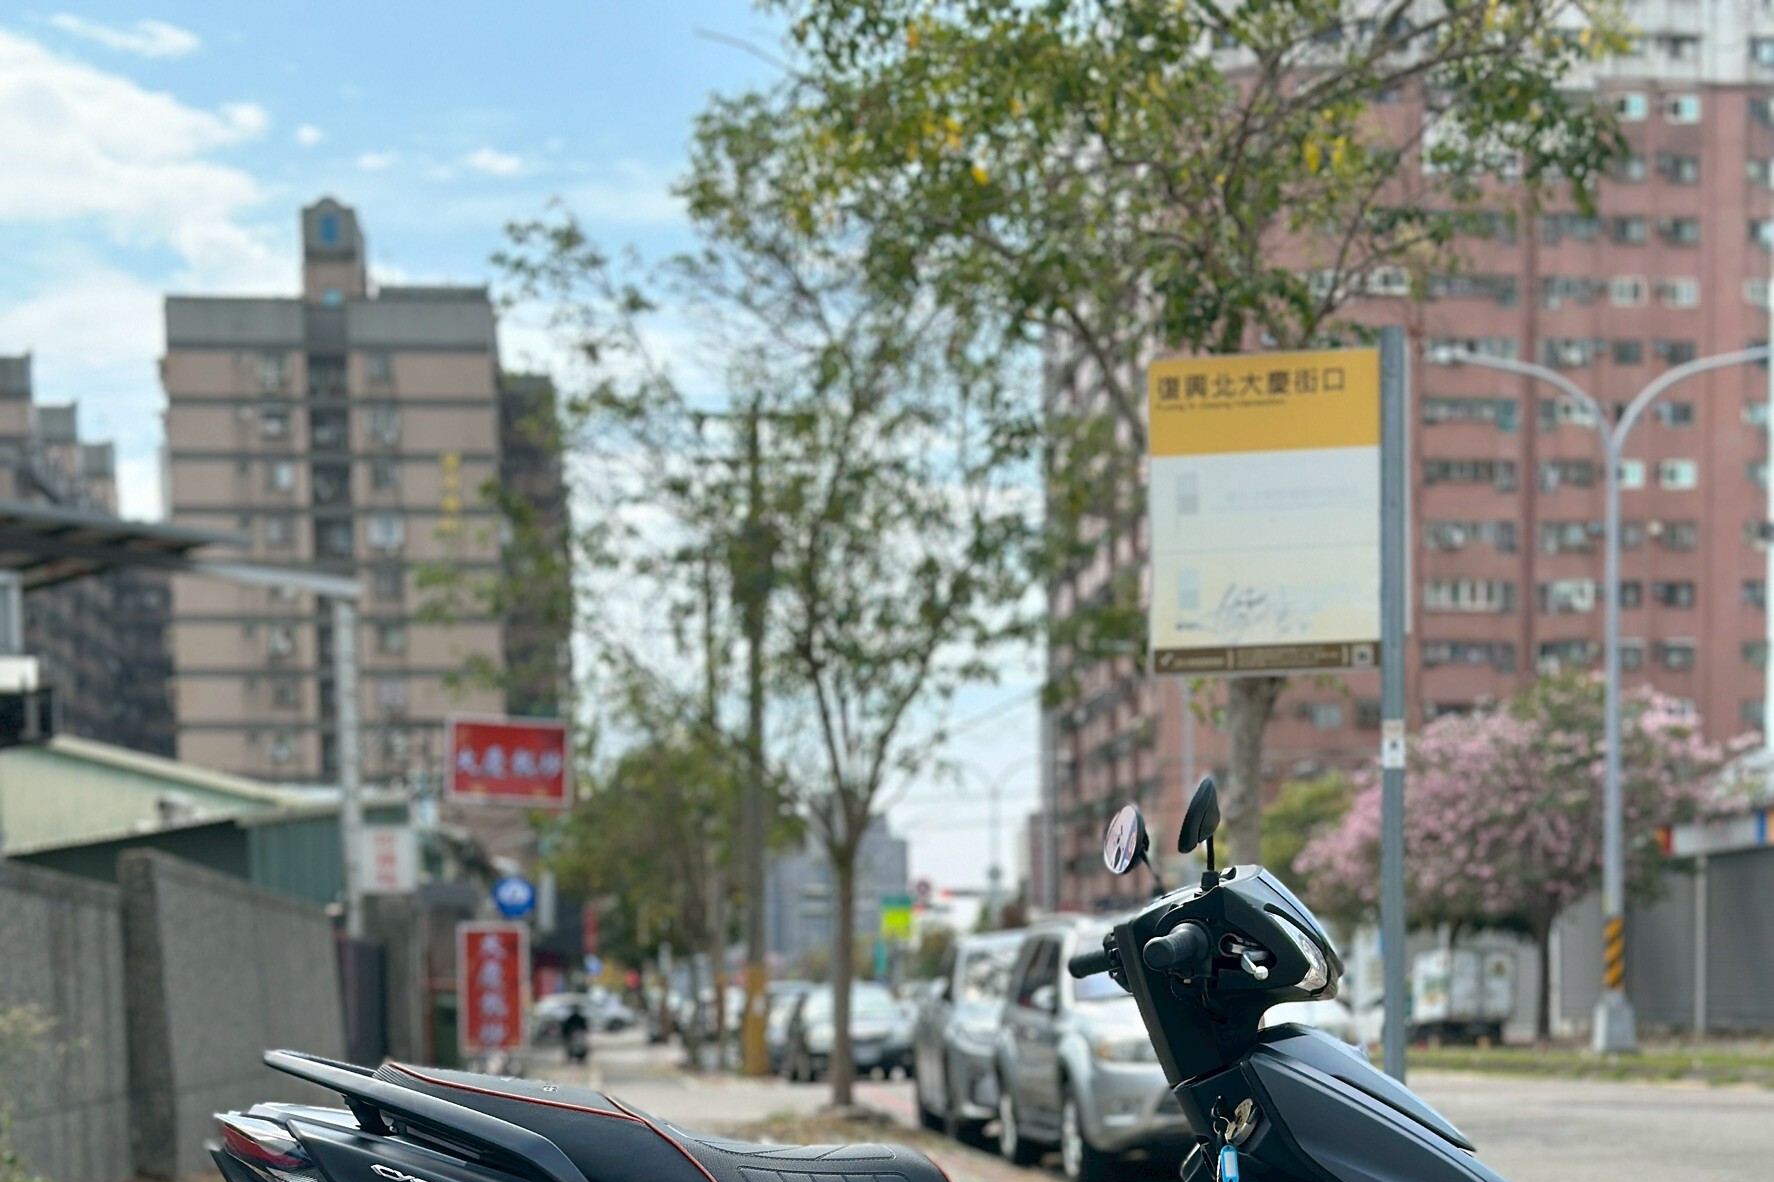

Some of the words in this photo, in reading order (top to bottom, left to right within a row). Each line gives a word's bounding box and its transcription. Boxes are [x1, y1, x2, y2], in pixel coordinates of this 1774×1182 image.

[1157, 367, 1346, 400] 復興北大慶街口
